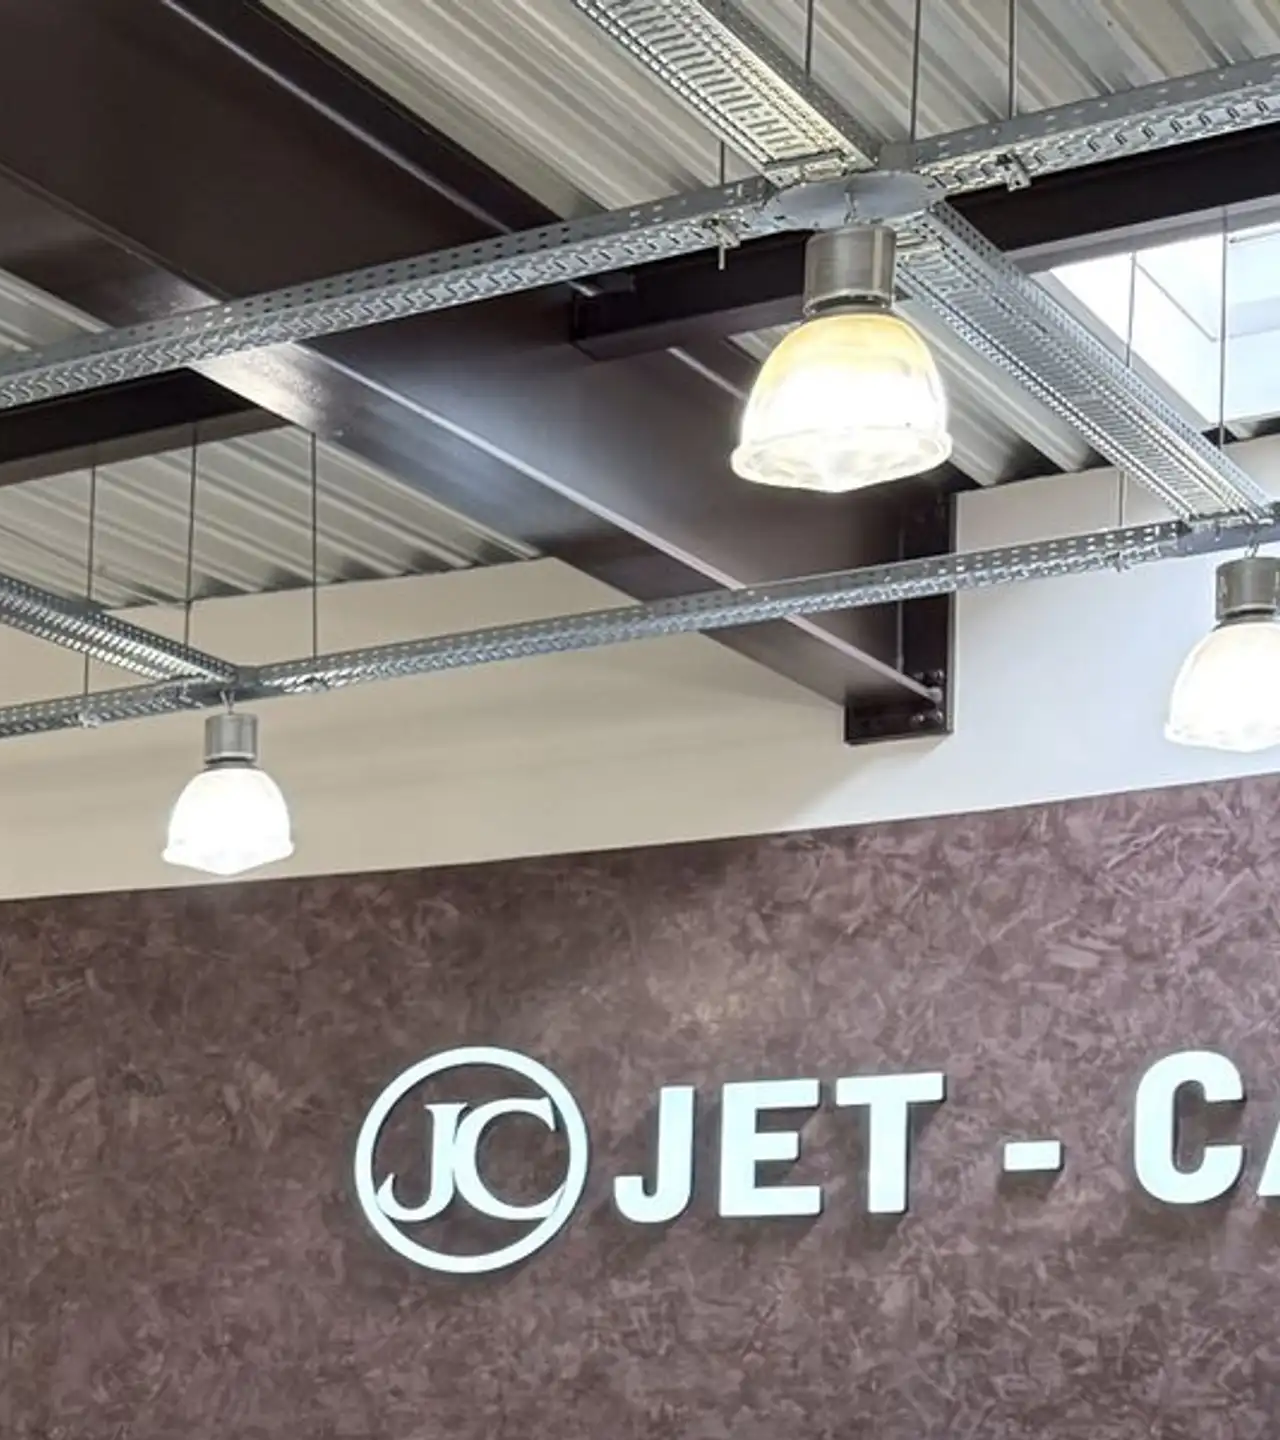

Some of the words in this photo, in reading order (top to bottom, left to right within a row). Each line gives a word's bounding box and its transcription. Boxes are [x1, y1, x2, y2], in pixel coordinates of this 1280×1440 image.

[374, 1094, 567, 1222] JC
[614, 1072, 947, 1223] JET
[1134, 1050, 1280, 1204] C
